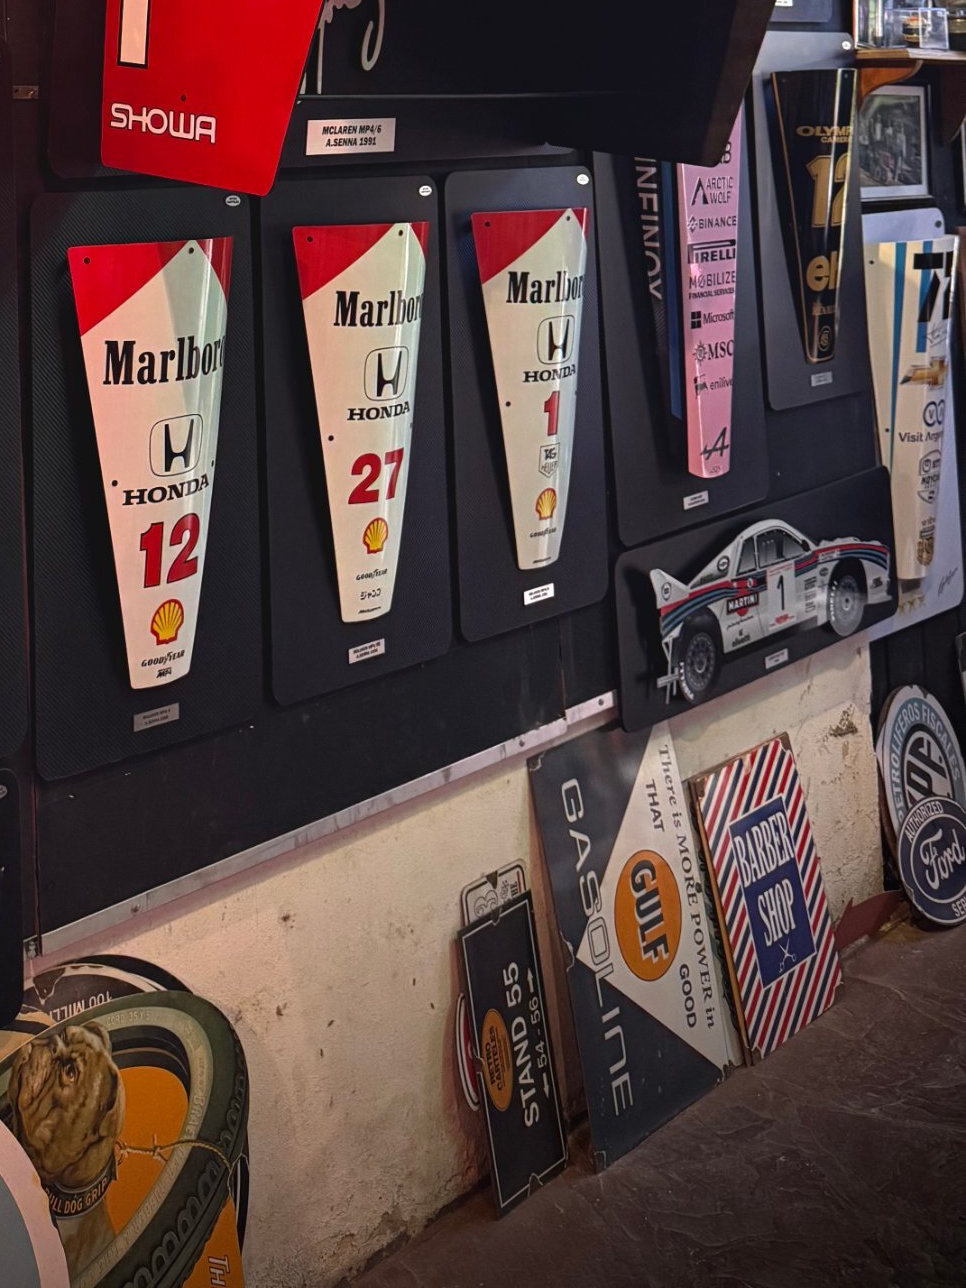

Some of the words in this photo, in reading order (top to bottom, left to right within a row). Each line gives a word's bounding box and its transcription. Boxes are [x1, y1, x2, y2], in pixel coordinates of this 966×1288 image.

[110, 103, 217, 144] SHOWA
[322, 125, 357, 136] MCLAREN
[358, 123, 382, 134] MP4/6
[325, 137, 358, 147] A.SENNA
[359, 136, 377, 146] 1991
[706, 176, 734, 190] ARCTIC
[709, 190, 732, 205] WOLF
[698, 215, 737, 230] BINANCE
[687, 239, 737, 265] PIRELLI
[506, 270, 585, 304] Marlbor
[707, 339, 734, 361] MSC
[522, 364, 576, 383] HONDA
[347, 400, 411, 421] HONDA
[544, 390, 560, 436] 1
[543, 447, 557, 460] TAG
[898, 431, 924, 443] Visit
[122, 473, 210, 506] HONDA
[347, 448, 405, 505] 27
[139, 513, 201, 589] 12
[355, 568, 388, 581] GOODYEAR
[777, 574, 785, 611] 1
[728, 593, 759, 612] MARTINI
[141, 649, 185, 667] GOODYEAR
[921, 703, 960, 782] FISCALES
[658, 743, 678, 806] There
[645, 778, 666, 833] THAT
[671, 809, 682, 829] is
[904, 800, 944, 843] AUTHORIZED
[734, 811, 794, 890] BARBER
[919, 827, 966, 890] Ford
[676, 834, 699, 908] MORE
[630, 859, 670, 965] GULF
[757, 877, 796, 949] SHOP
[560, 777, 634, 1117] GASOLINE
[690, 911, 715, 1005] POWER
[503, 961, 523, 1009] 55
[678, 962, 697, 1030] GOOD
[530, 996, 542, 1026] 56
[700, 1008, 715, 1029] in
[487, 1041, 496, 1086] RETRO
[488, 1025, 503, 1092] CARTELES
[510, 1015, 541, 1128] STAND
[536, 1040, 548, 1070] 54
[63, 1198, 83, 1215] DOG
[86, 1177, 109, 1208] GRIP
